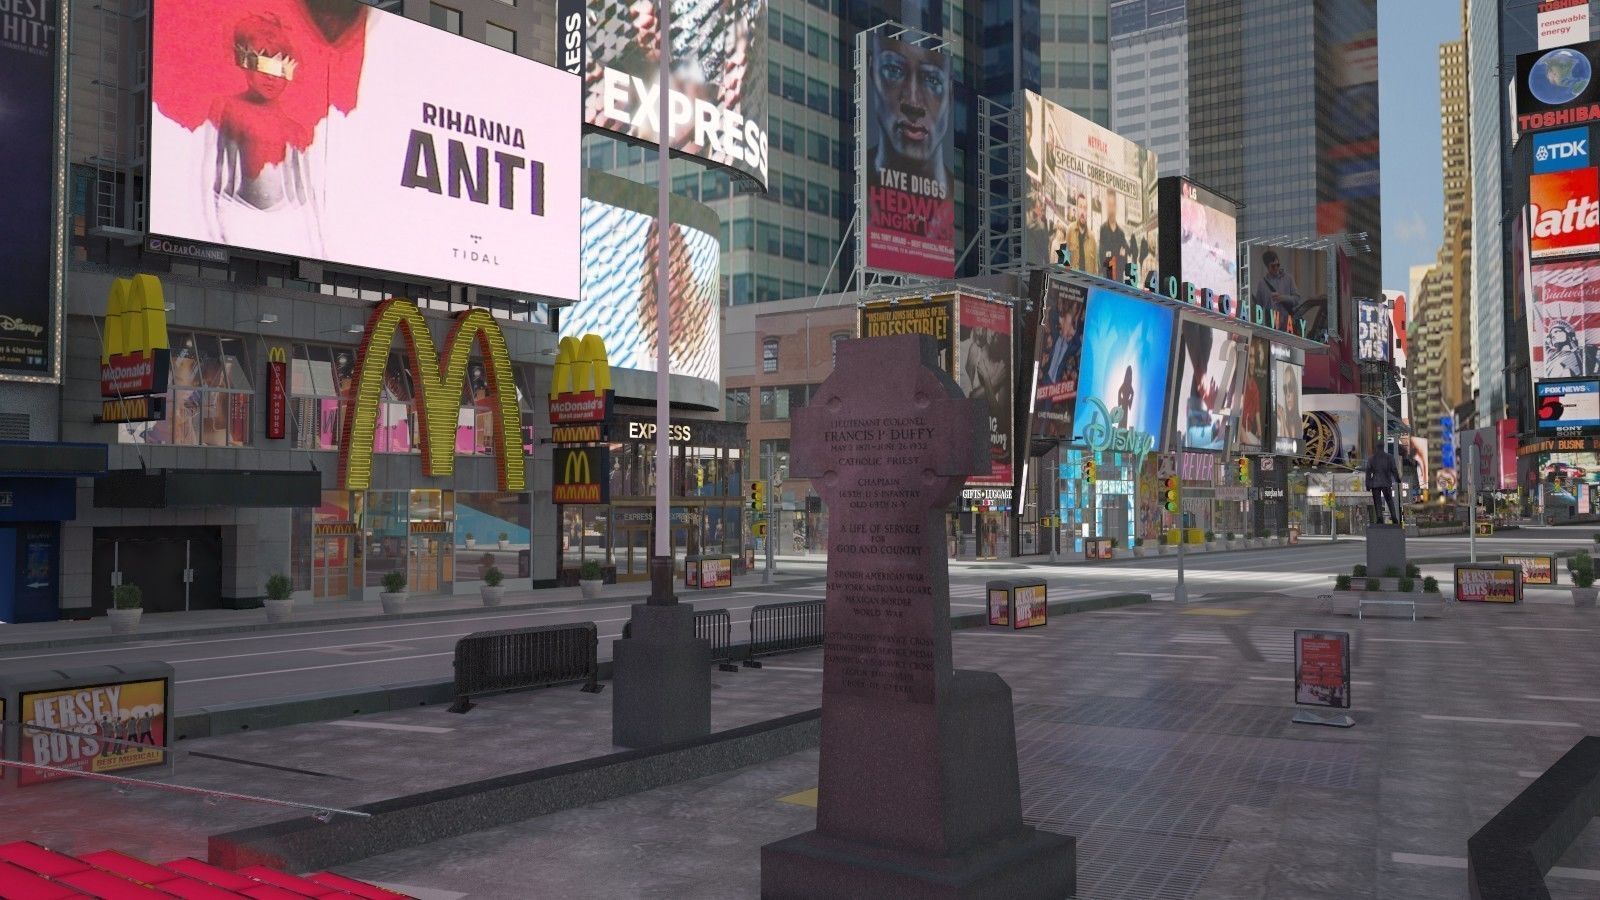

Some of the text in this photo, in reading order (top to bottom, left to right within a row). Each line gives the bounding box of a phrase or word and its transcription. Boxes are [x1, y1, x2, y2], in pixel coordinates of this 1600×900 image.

[1541, 13, 1587, 28] renewable
[1541, 25, 1571, 37] energy
[1518, 104, 1600, 130] TOSHIBA
[423, 102, 526, 150] RIHANNA
[1547, 139, 1587, 160] TDK
[401, 129, 544, 217] ANTI
[1056, 149, 1138, 197] SPECIAL CORRESPONDENTS
[878, 167, 946, 200] TAYE DIGGS
[452, 247, 500, 267] TIDAL
[102, 361, 152, 382] McDonald's
[1544, 385, 1586, 394] FOX NEWS
[550, 399, 603, 413] McDonald's
[558, 411, 594, 420] Restaurant
[629, 421, 692, 442] EXPESS
[824, 429, 875, 442] FRANCIS
[890, 428, 936, 441] DUFFY
[838, 456, 920, 466] CATHOLIC PRIEST
[858, 478, 900, 487] CHAPLAIN
[962, 489, 1013, 500] GIFTS LUGGAGE
[624, 513, 653, 521] EXPRESS
[884, 524, 921, 534] SERVICE
[836, 544, 857, 554] GOD
[880, 545, 922, 556] COUNTRY
[33, 685, 121, 730] JERSEY
[32, 733, 100, 768] BOYS
[96, 756, 117, 768] BEST
[118, 750, 160, 765] MUSICAL!
